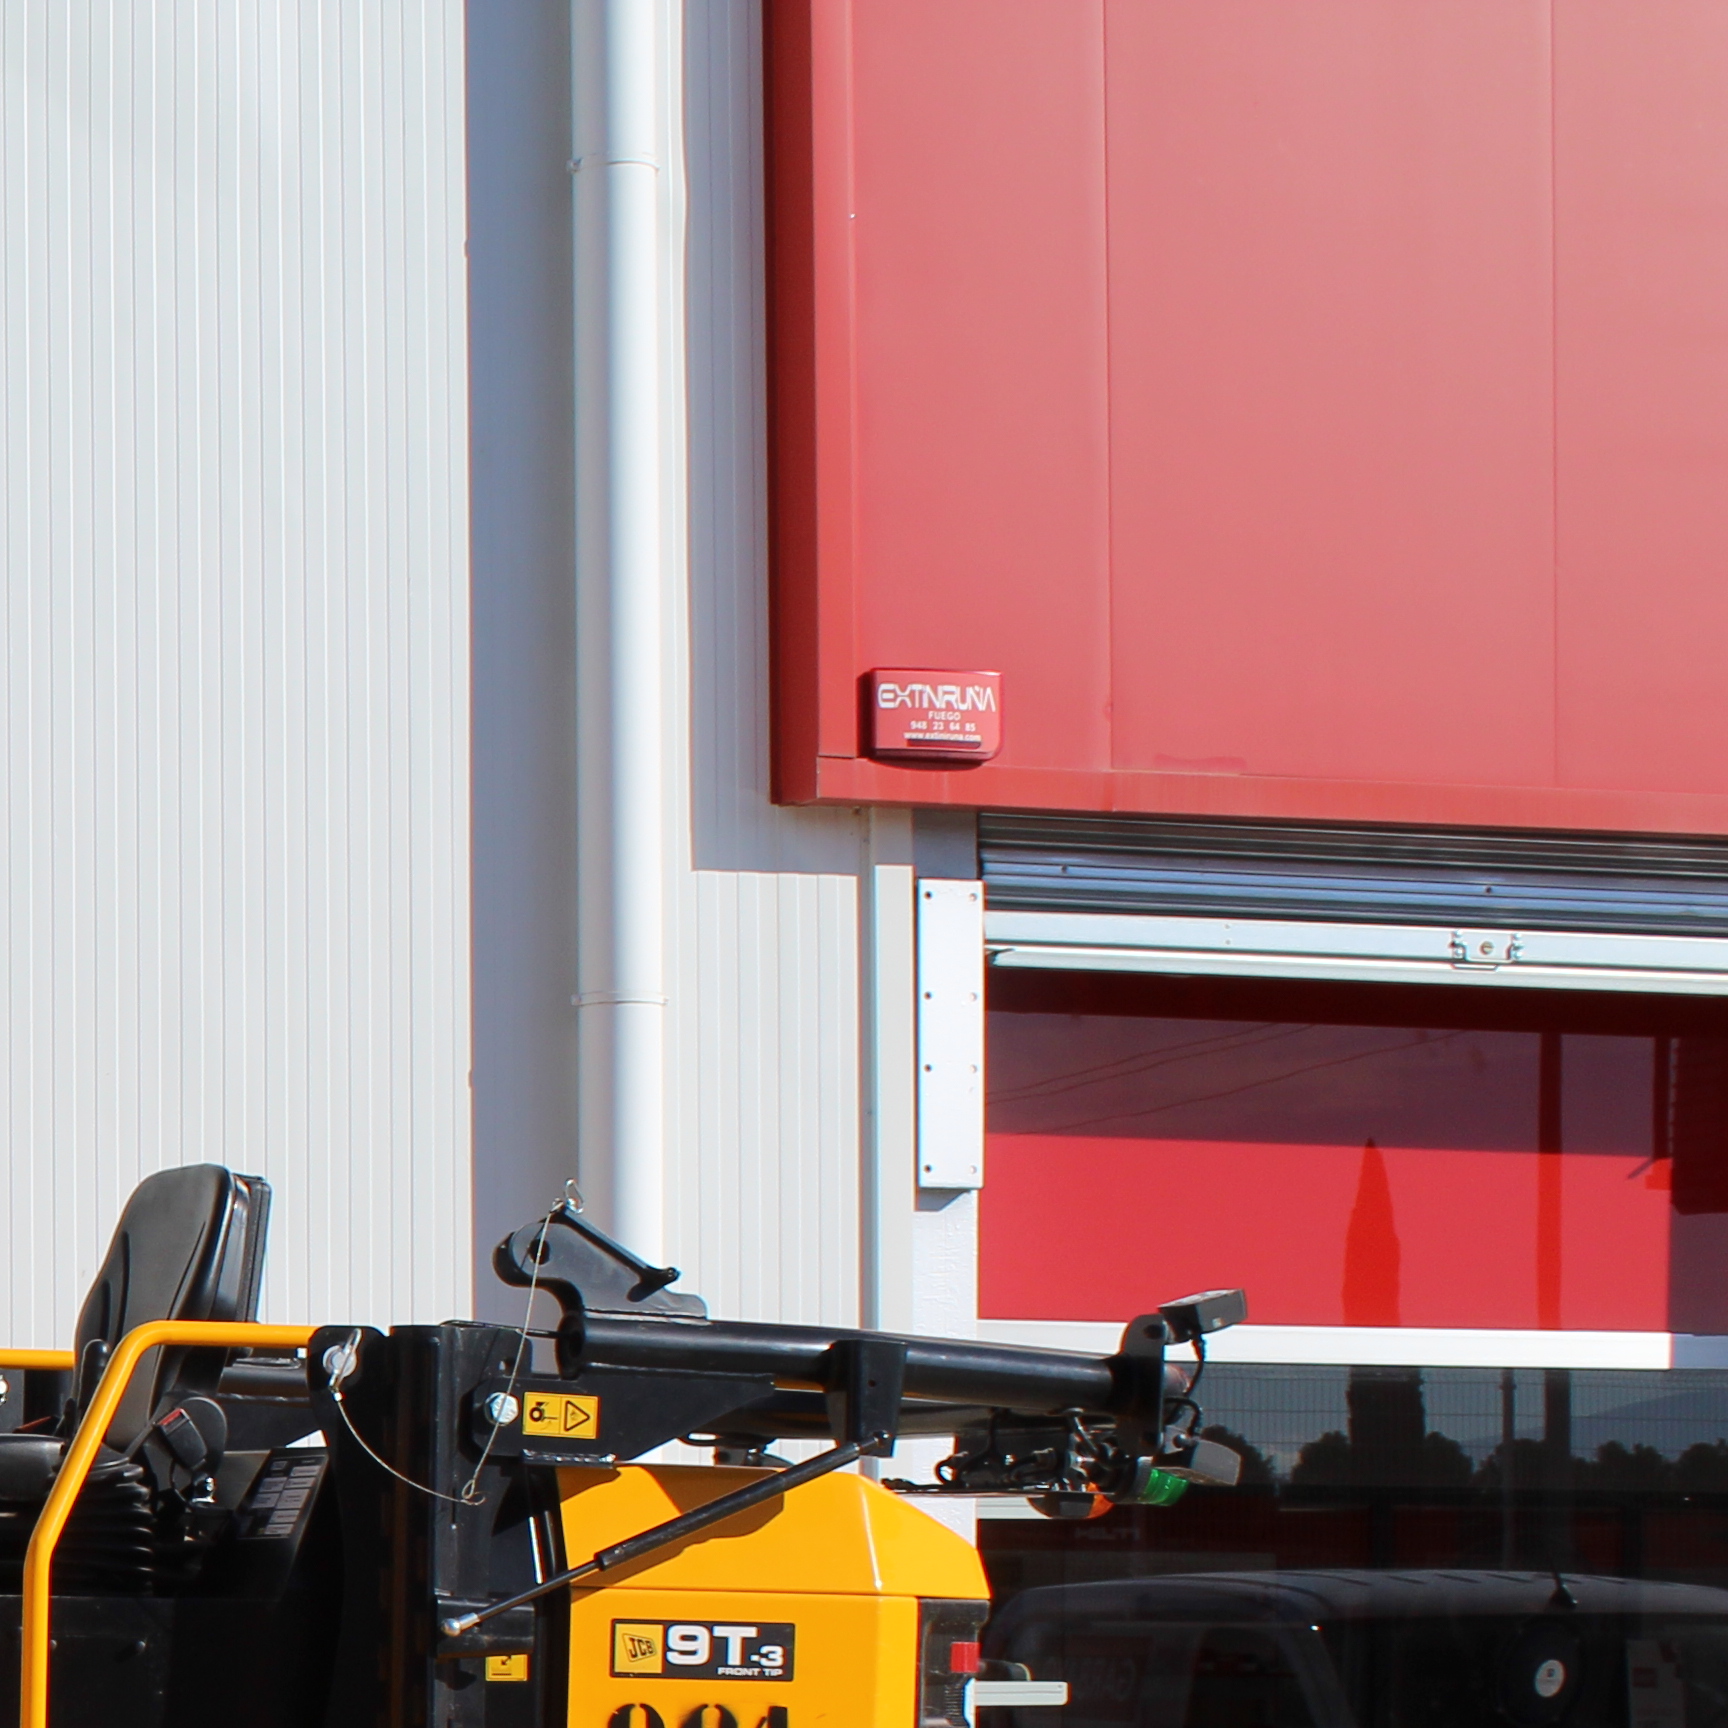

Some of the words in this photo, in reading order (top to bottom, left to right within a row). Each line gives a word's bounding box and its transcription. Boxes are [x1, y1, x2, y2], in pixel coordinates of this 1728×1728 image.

[928, 711, 961, 720] FUEGO
[910, 721, 927, 730] 948
[629, 1637, 655, 1659] JCB
[717, 1667, 761, 1676] FRONT
[764, 1668, 784, 1676] TIP
